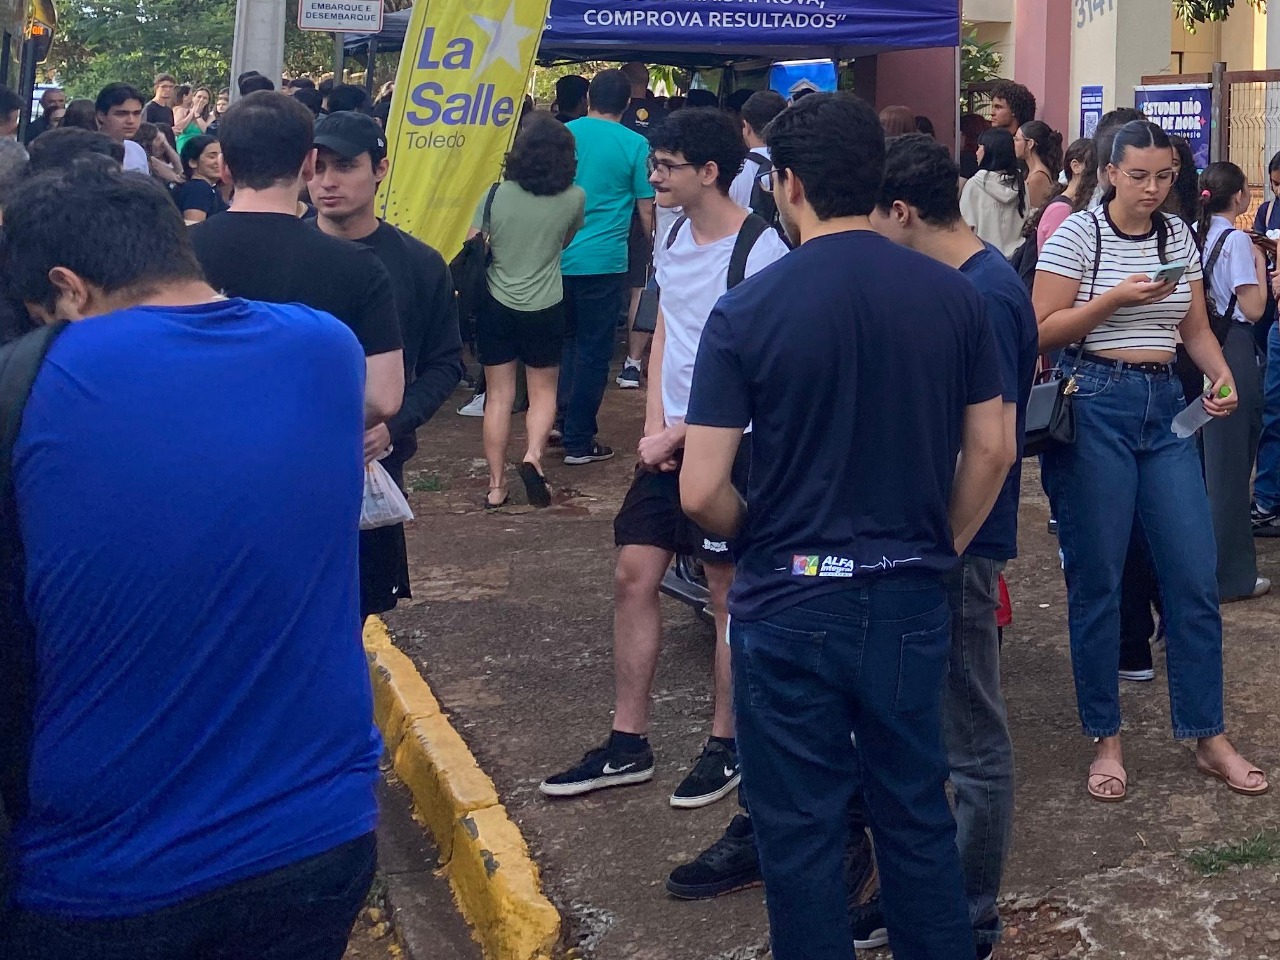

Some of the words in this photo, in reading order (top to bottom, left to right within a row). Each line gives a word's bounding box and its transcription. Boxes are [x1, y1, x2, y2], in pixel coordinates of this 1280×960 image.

[305, 11, 377, 22] DESEMBARQUE
[311, 2, 364, 12] EMBARQUE
[365, 4, 372, 12] E
[583, 9, 704, 28] COMPROVA
[708, 12, 847, 30] RESULTADOS”
[416, 26, 474, 70] La
[406, 81, 514, 128] Salle
[405, 131, 466, 150] Toledo
[821, 555, 854, 569] ALFA
